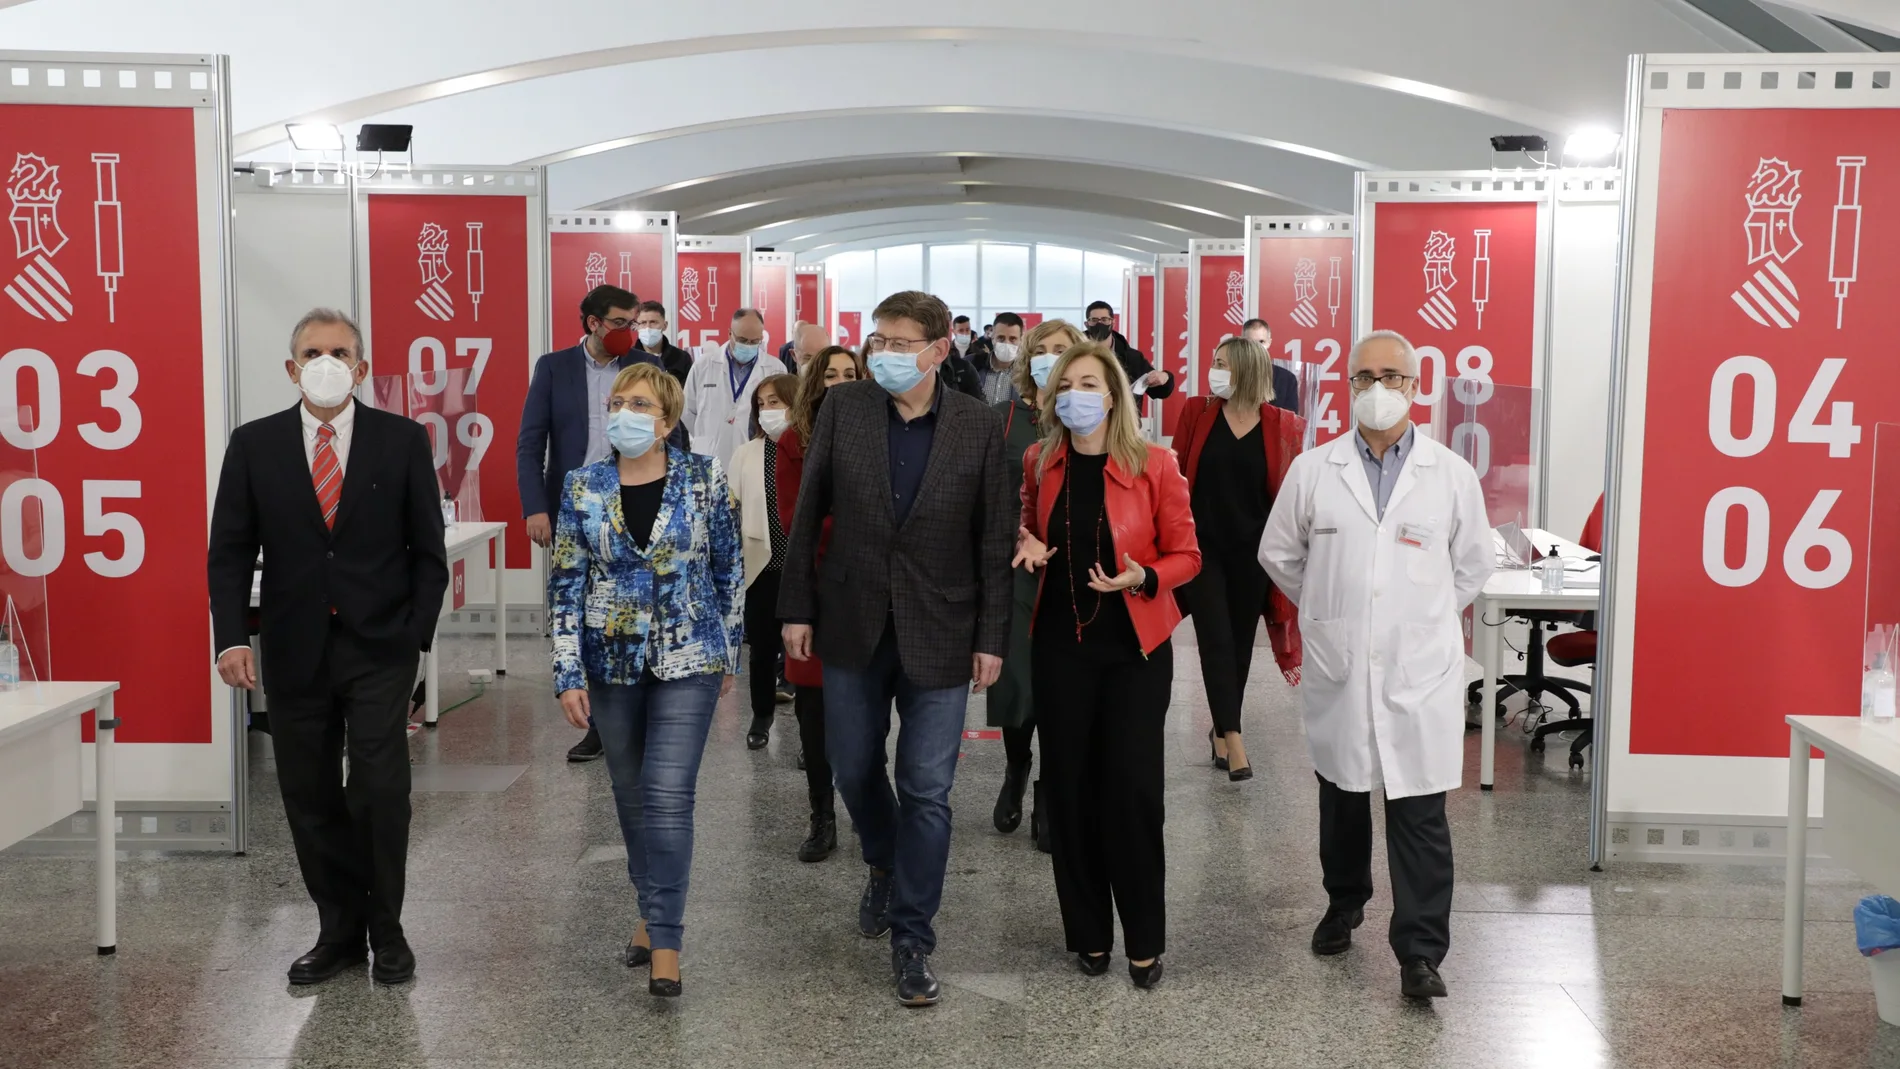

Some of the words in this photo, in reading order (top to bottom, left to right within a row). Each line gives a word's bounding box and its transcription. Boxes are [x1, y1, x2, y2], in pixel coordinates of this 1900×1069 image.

[408, 336, 493, 396] 07
[1284, 338, 1341, 381] 12
[1412, 345, 1495, 406] 08
[0, 348, 142, 451] 03
[1316, 392, 1342, 434] 4
[1708, 355, 1862, 458] 04
[415, 412, 494, 471] 09
[0, 478, 146, 578] 05
[1702, 486, 1853, 589] 06
